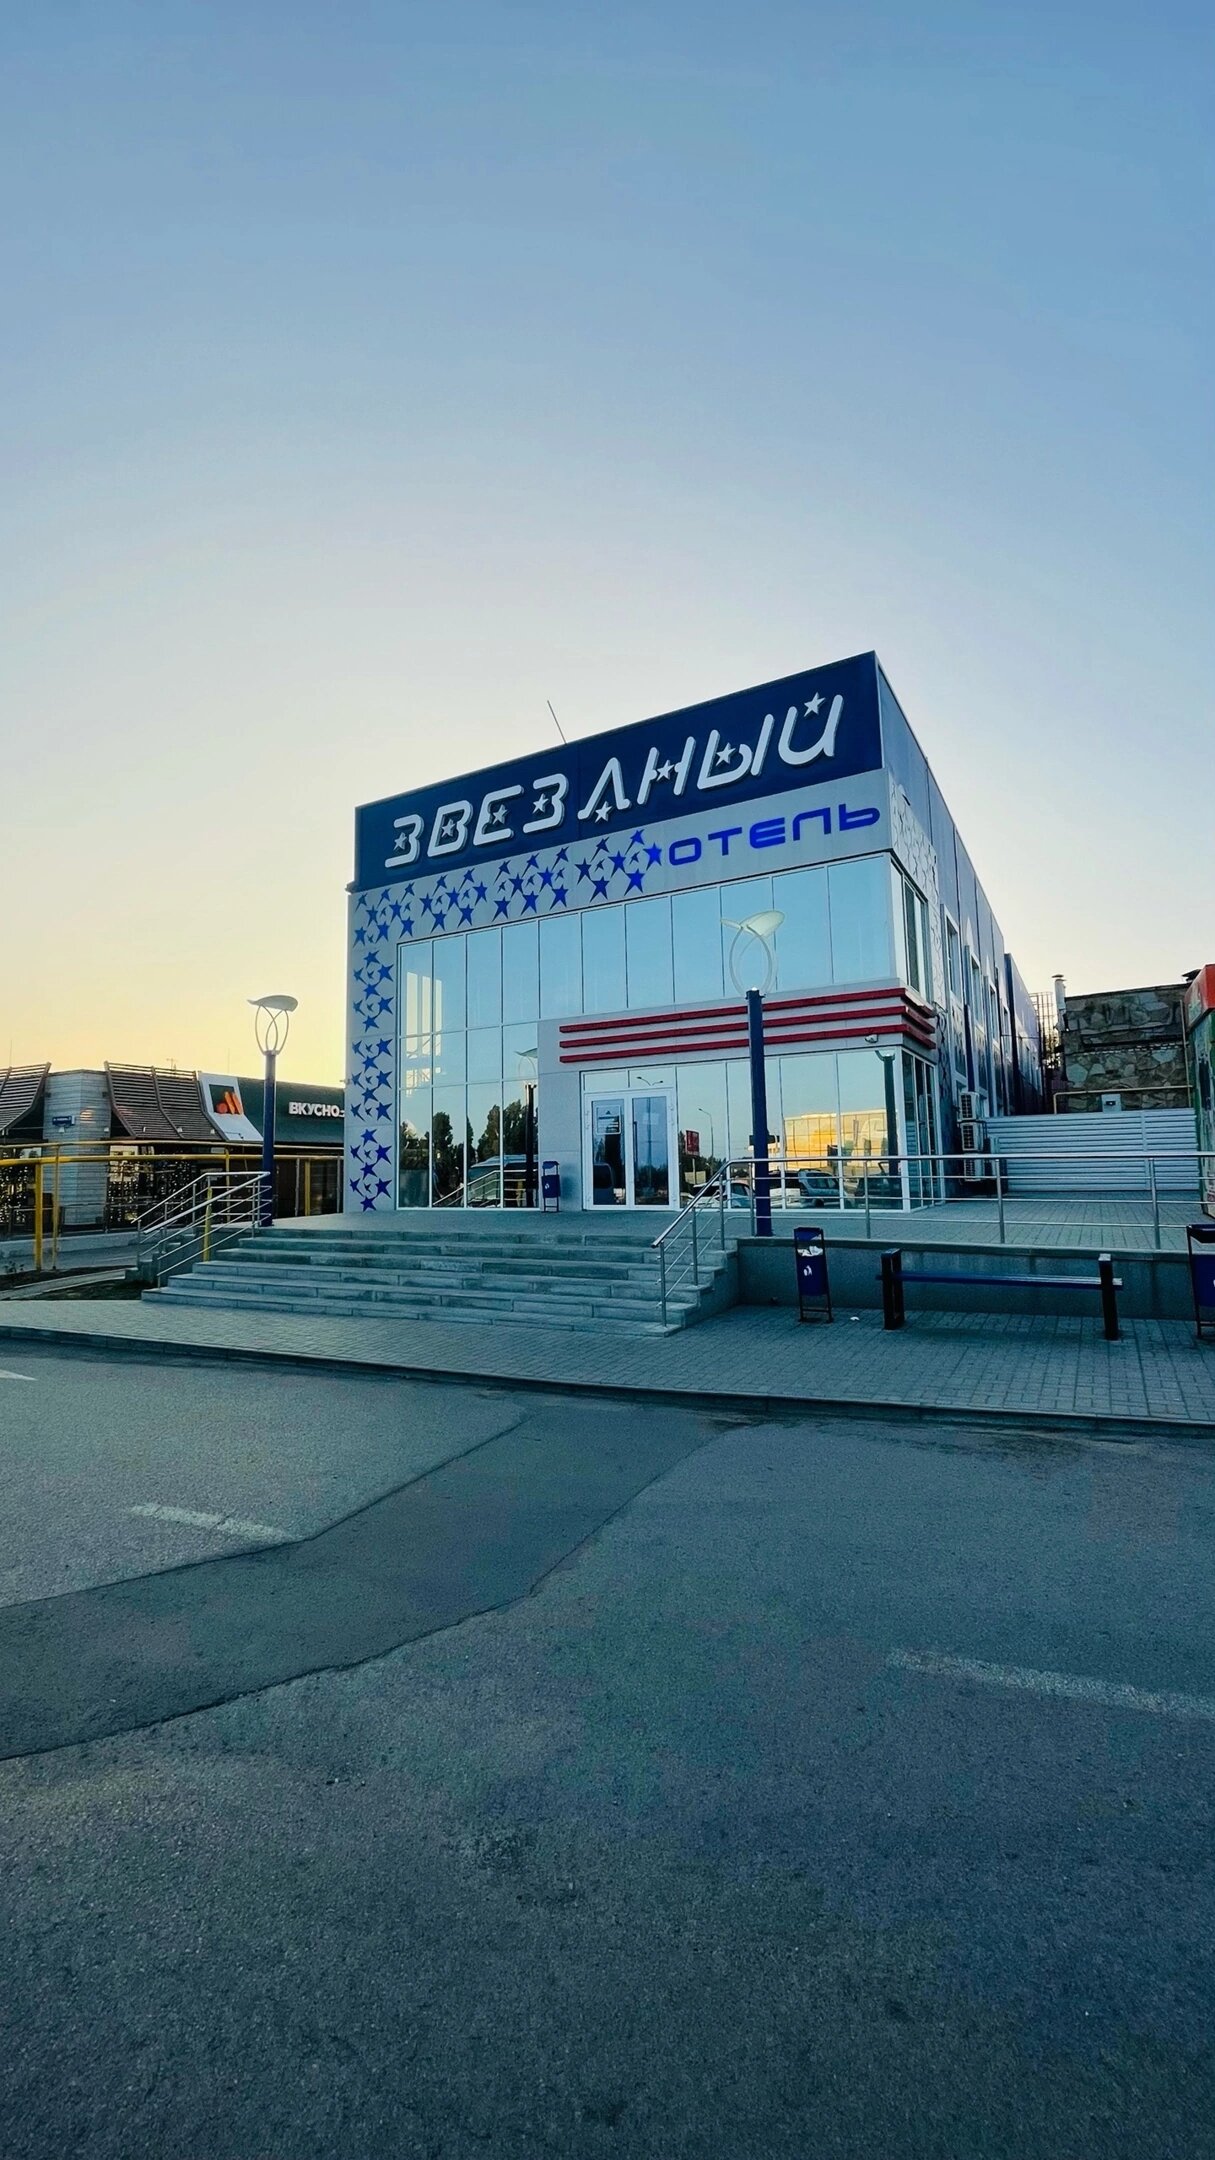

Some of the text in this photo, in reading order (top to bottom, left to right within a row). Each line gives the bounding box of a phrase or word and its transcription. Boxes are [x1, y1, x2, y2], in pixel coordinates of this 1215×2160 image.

[384, 692, 844, 869] ЗВЕЗДНЫЙ
[668, 803, 881, 867] ОТЕЛЬ
[288, 1101, 341, 1118] ВКУСНО
